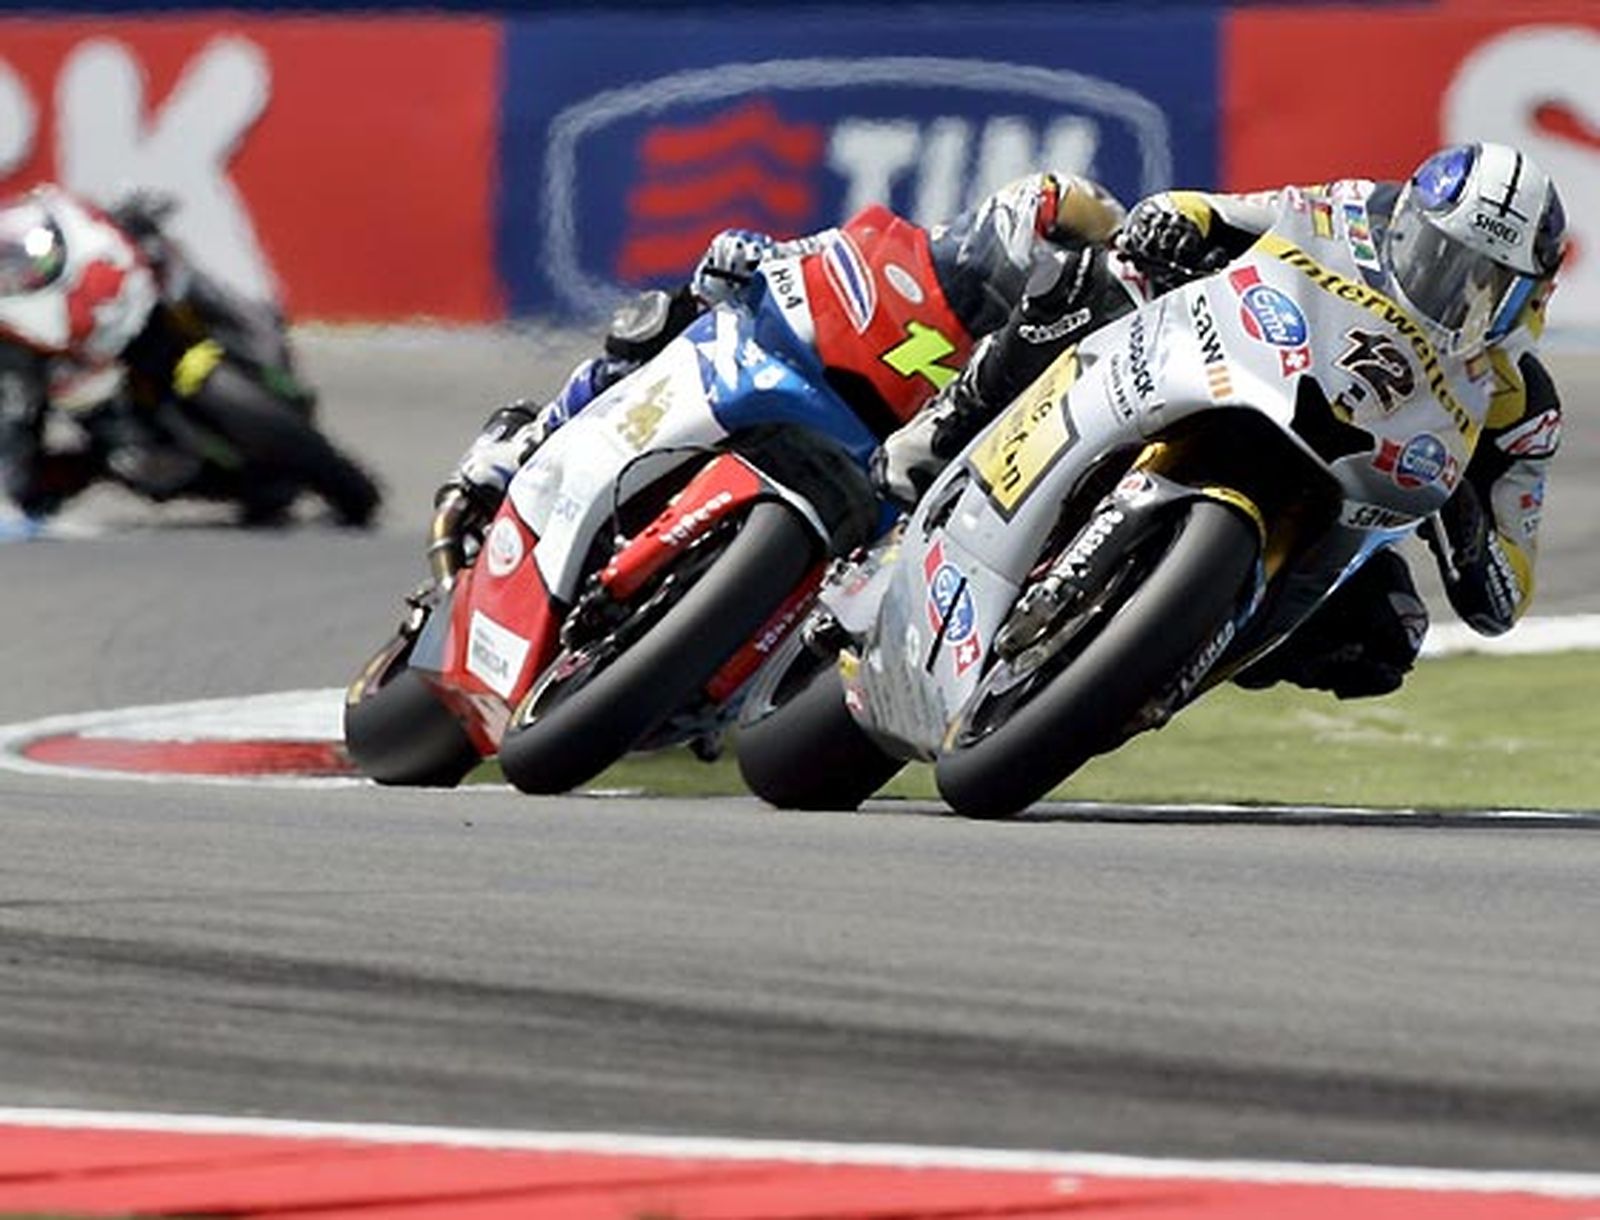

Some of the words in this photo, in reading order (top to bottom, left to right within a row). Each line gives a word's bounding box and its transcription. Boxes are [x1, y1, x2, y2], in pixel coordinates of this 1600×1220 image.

[828, 115, 1099, 227] TIM
[1473, 211, 1519, 245] SHOEI
[1279, 249, 1471, 433] Interwetten
[1334, 328, 1416, 415] 12
